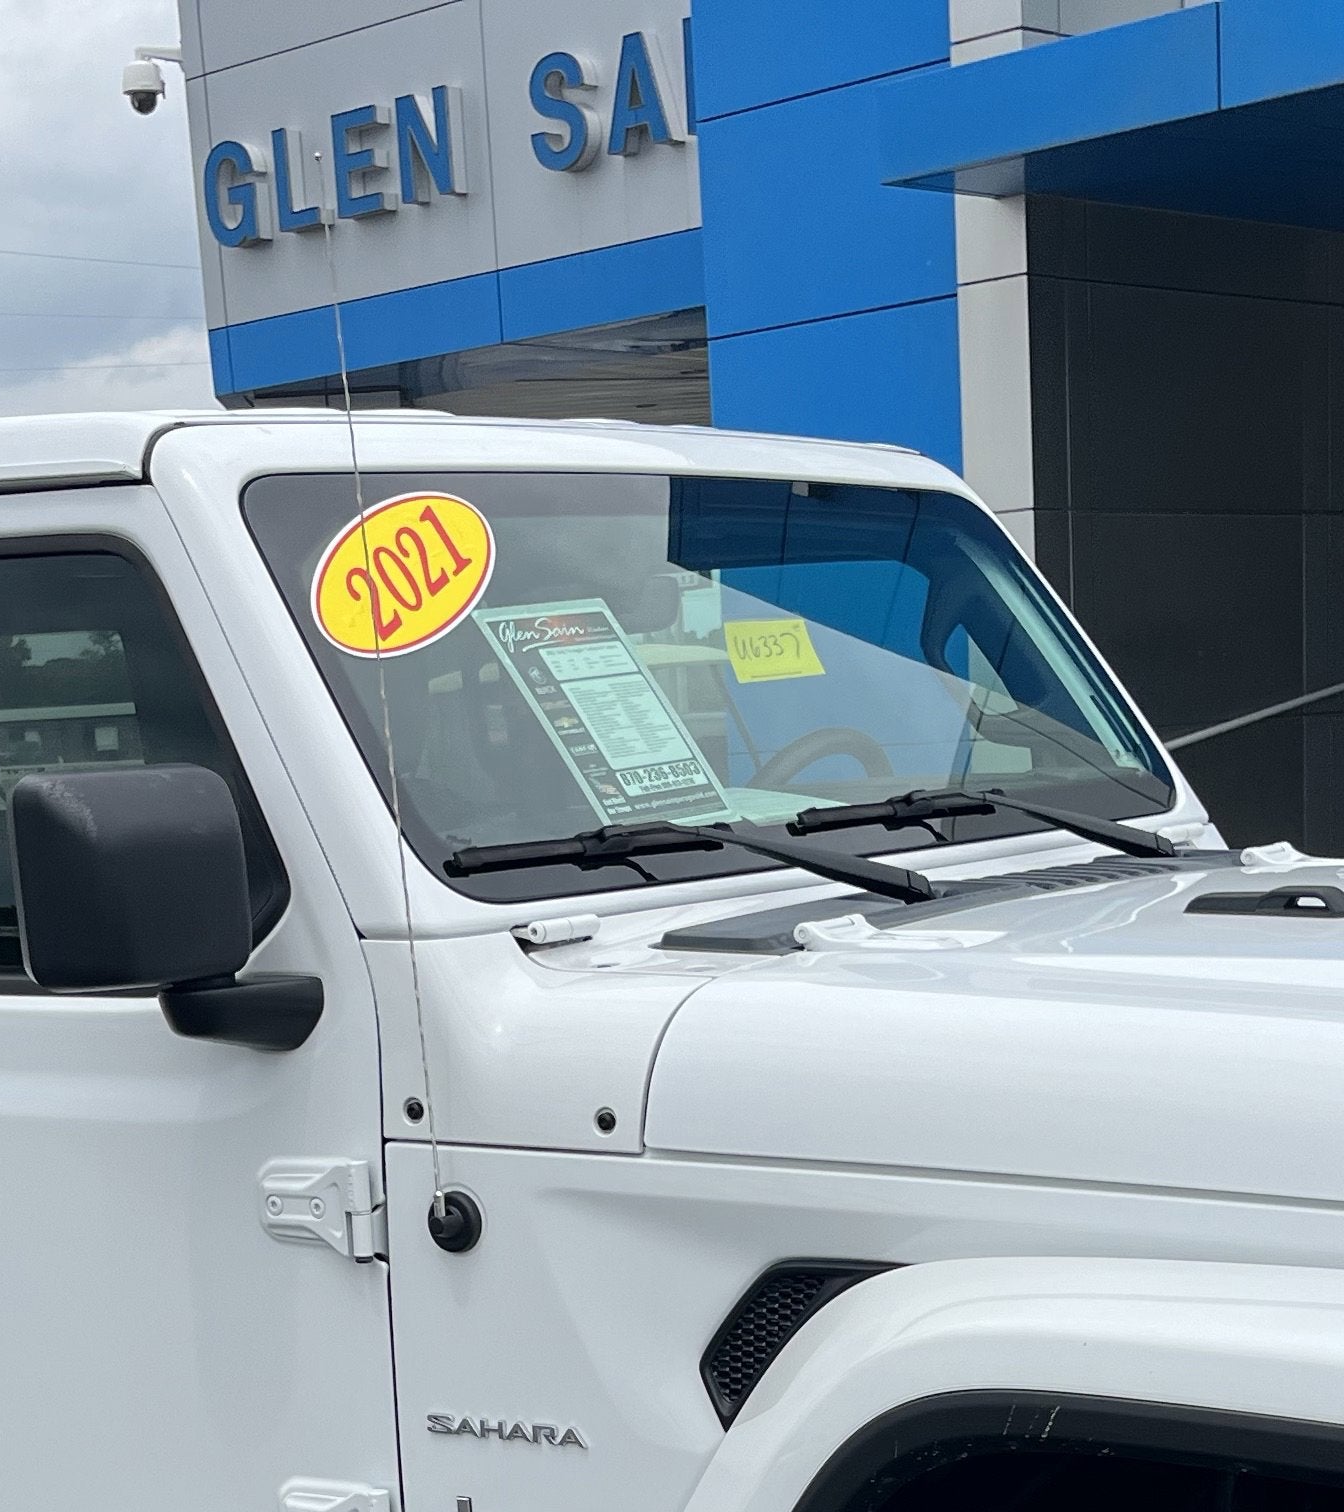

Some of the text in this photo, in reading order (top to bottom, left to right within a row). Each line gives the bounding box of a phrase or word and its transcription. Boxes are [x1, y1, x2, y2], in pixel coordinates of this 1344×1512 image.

[204, 85, 468, 248] GLEN
[346, 505, 472, 641] 2021
[499, 617, 585, 653] Glen Sain
[426, 1412, 589, 1449] SAHARA
